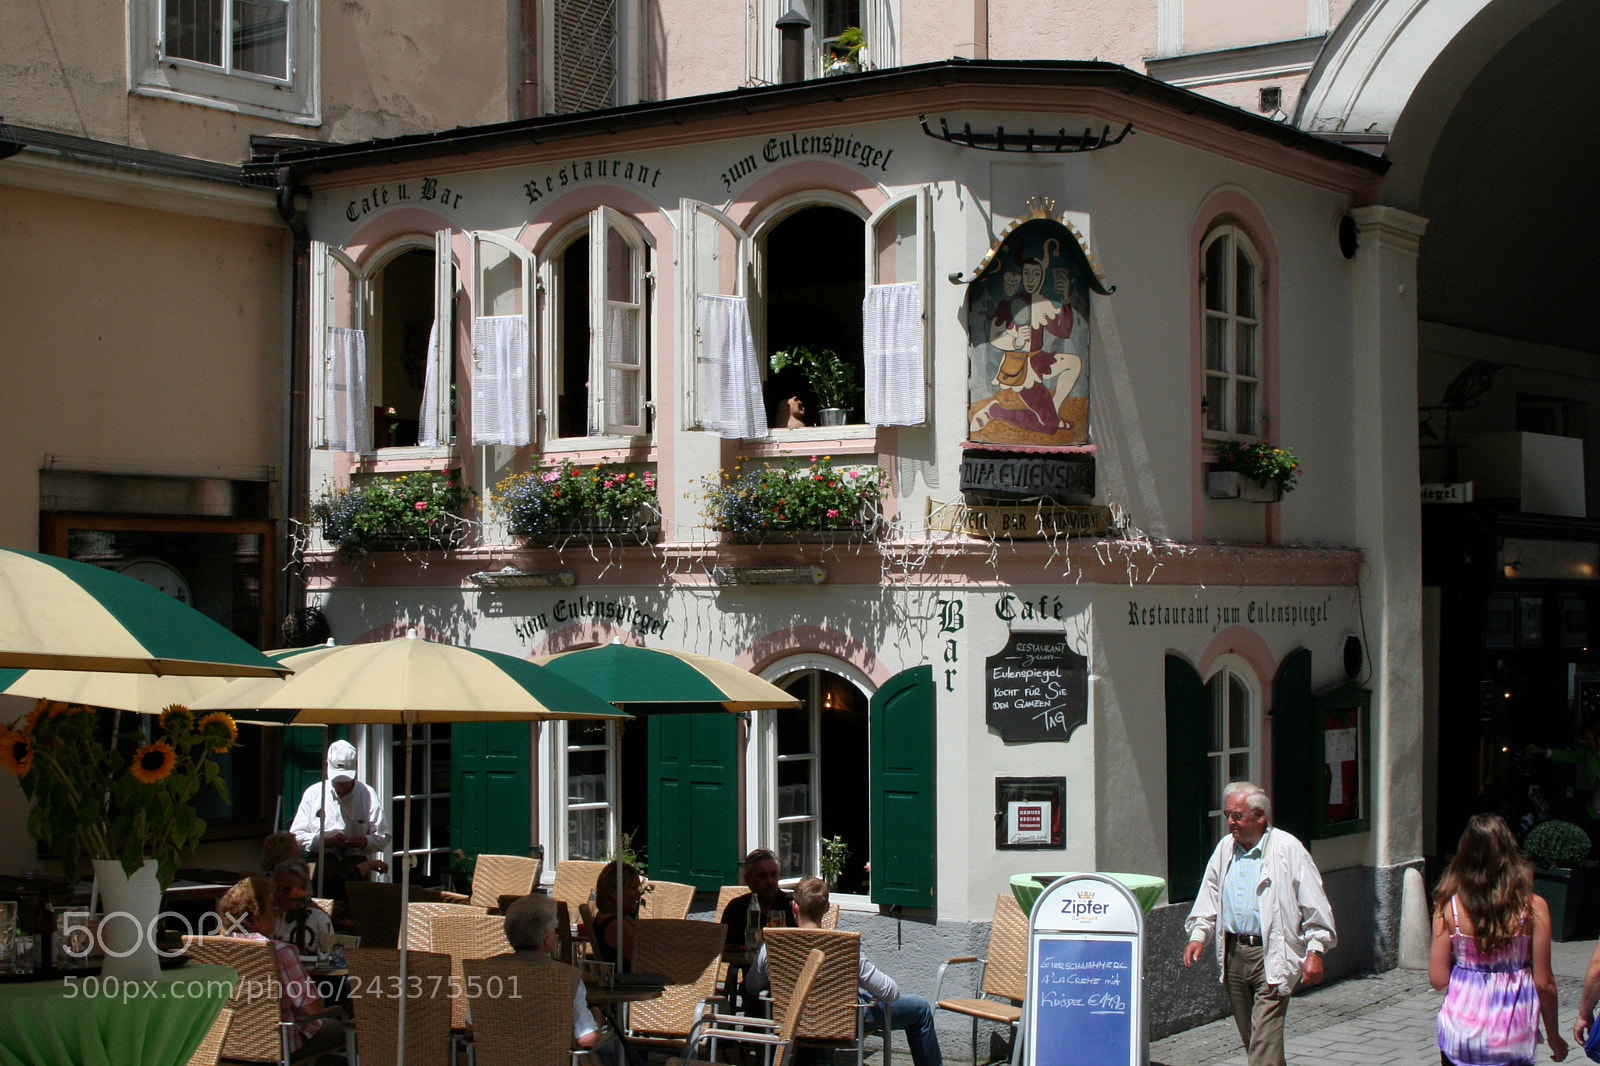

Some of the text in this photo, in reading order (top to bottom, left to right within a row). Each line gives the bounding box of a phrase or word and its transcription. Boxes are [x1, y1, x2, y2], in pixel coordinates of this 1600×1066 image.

[720, 133, 894, 193] zum Eulenspiegel
[523, 159, 661, 205] Restaurant
[346, 184, 389, 222] Café
[419, 177, 463, 210] Bar
[1003, 513, 1027, 530] BAR
[994, 595, 1064, 621] Café
[1128, 601, 1209, 626] Restaurant
[515, 597, 669, 647] zum Eulenspiegel
[1016, 642, 1067, 654] RESTAURANT
[993, 667, 1062, 684] Eulenspiegel
[1061, 899, 1110, 916] Zipfer
